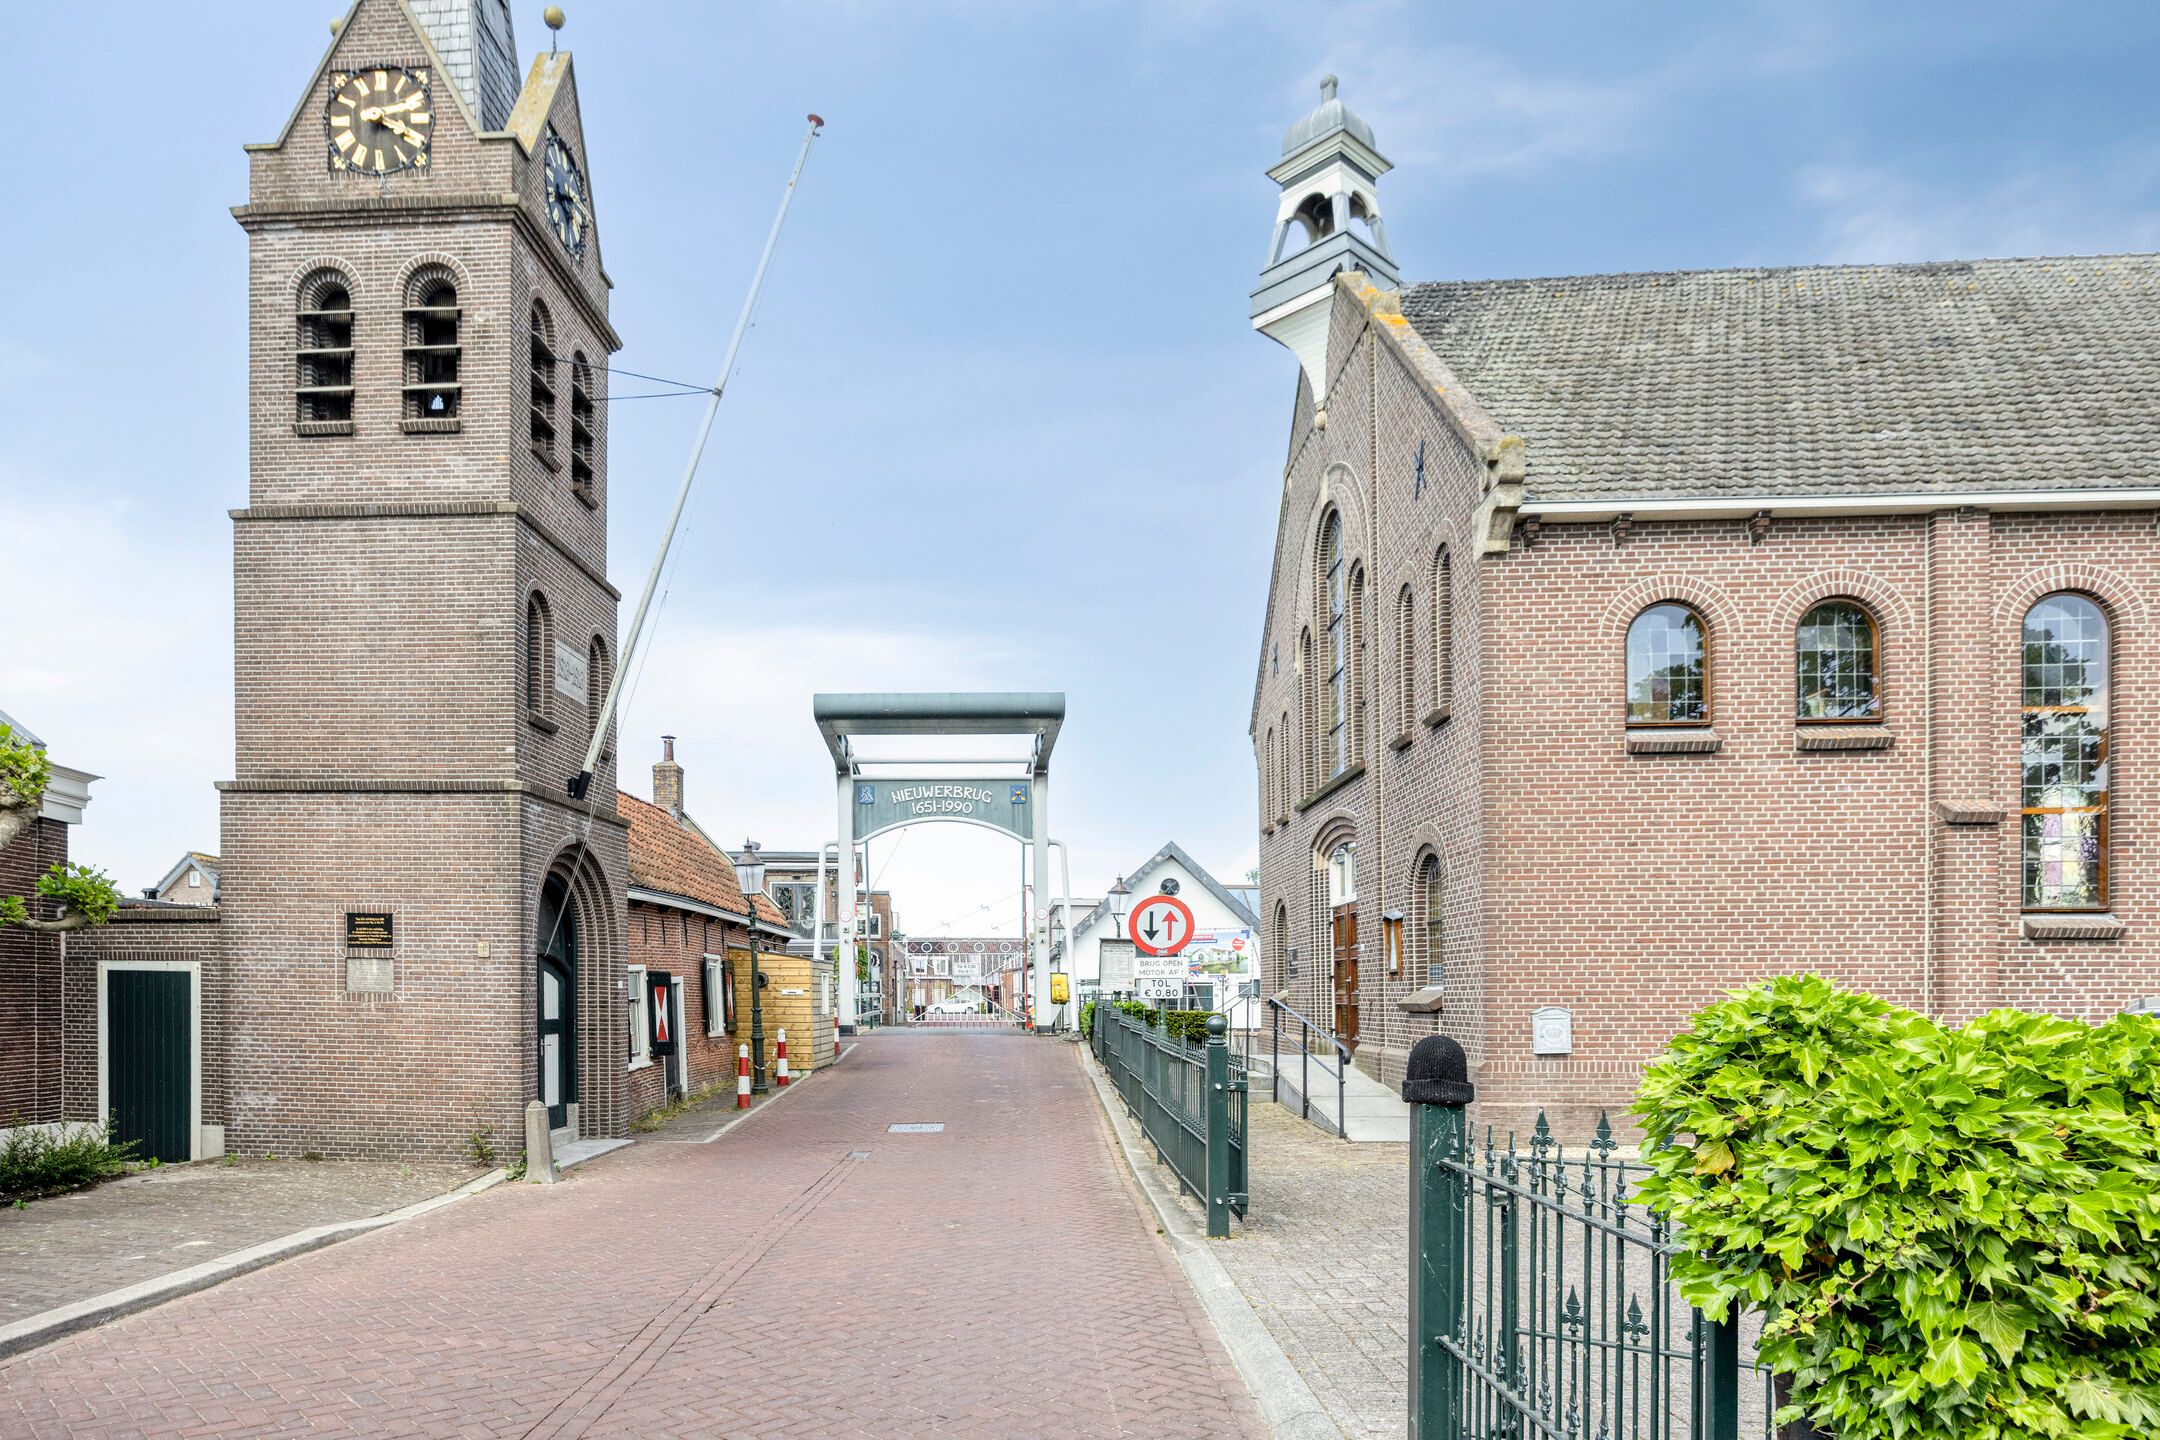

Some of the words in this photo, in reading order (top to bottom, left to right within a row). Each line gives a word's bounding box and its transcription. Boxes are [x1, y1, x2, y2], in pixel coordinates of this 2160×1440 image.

[891, 785, 992, 803] NIEUWERBRUG
[912, 800, 972, 814] 1651-1990
[1151, 979, 1171, 987] TOL
[1144, 989, 1151, 997] €
